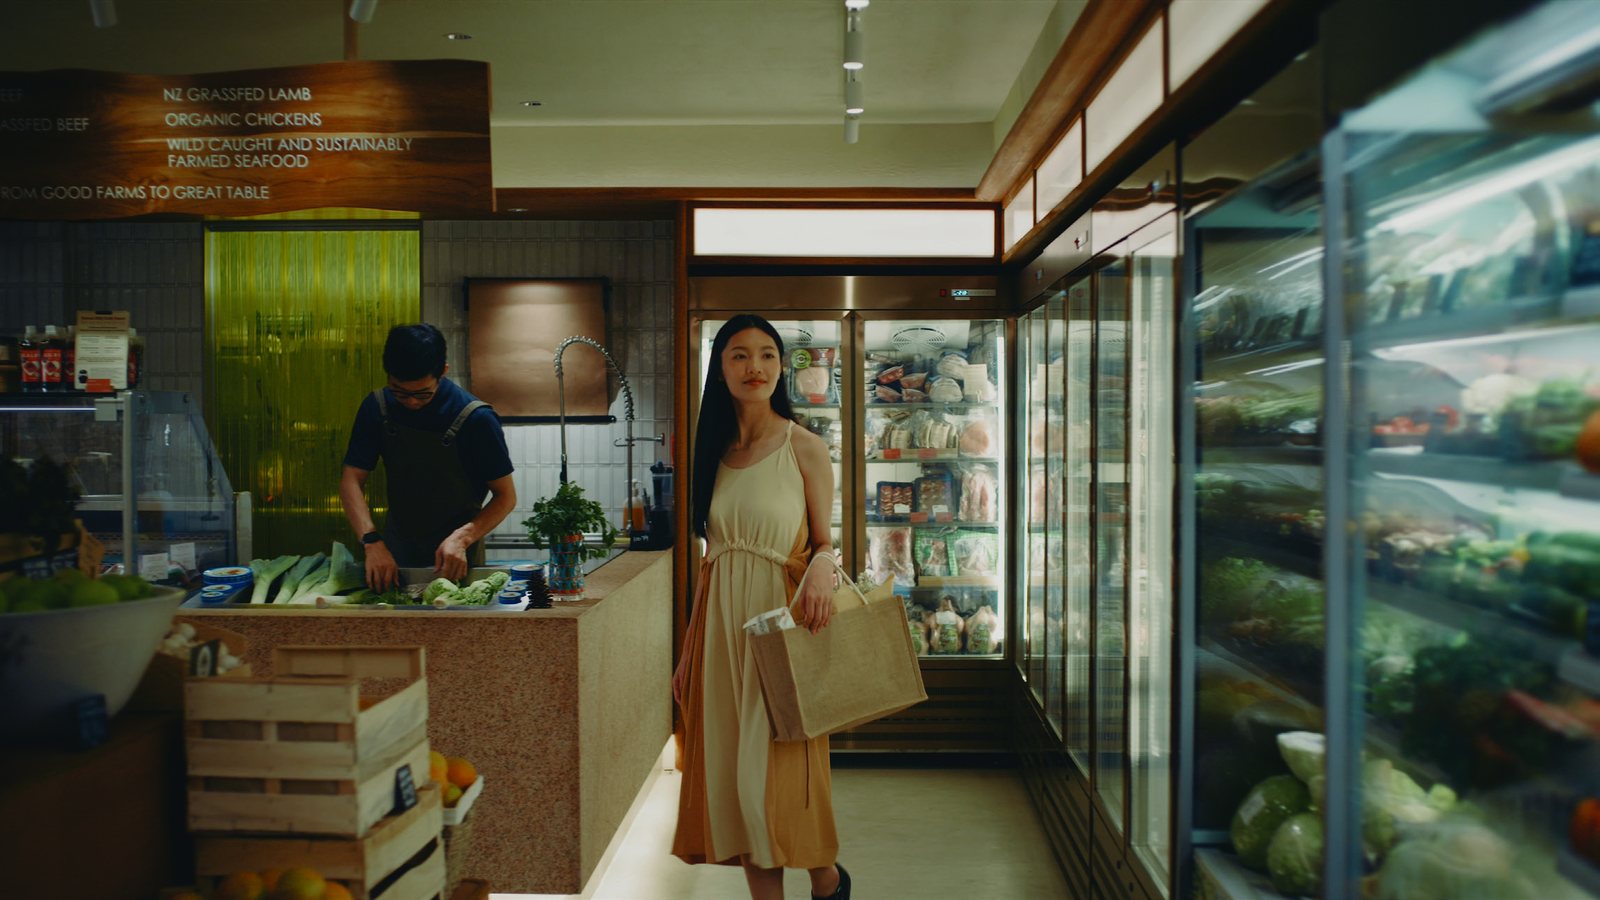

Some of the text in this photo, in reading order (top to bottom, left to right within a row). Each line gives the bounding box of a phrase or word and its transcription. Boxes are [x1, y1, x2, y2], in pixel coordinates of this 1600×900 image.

[163, 87, 312, 102] NZ GRASSFED LAMB
[57, 118, 90, 131] BEEF
[165, 112, 322, 127] ORGANIC CHICKENS
[167, 137, 413, 151] WILD CAUGHT AND SUSTAINABLY
[168, 153, 309, 168] FARMED SEAFOOD
[41, 185, 93, 200] GOOD
[96, 185, 147, 200] FARMS
[149, 185, 170, 200] TO
[173, 185, 224, 200] GREAT
[225, 185, 270, 200] TABLE
